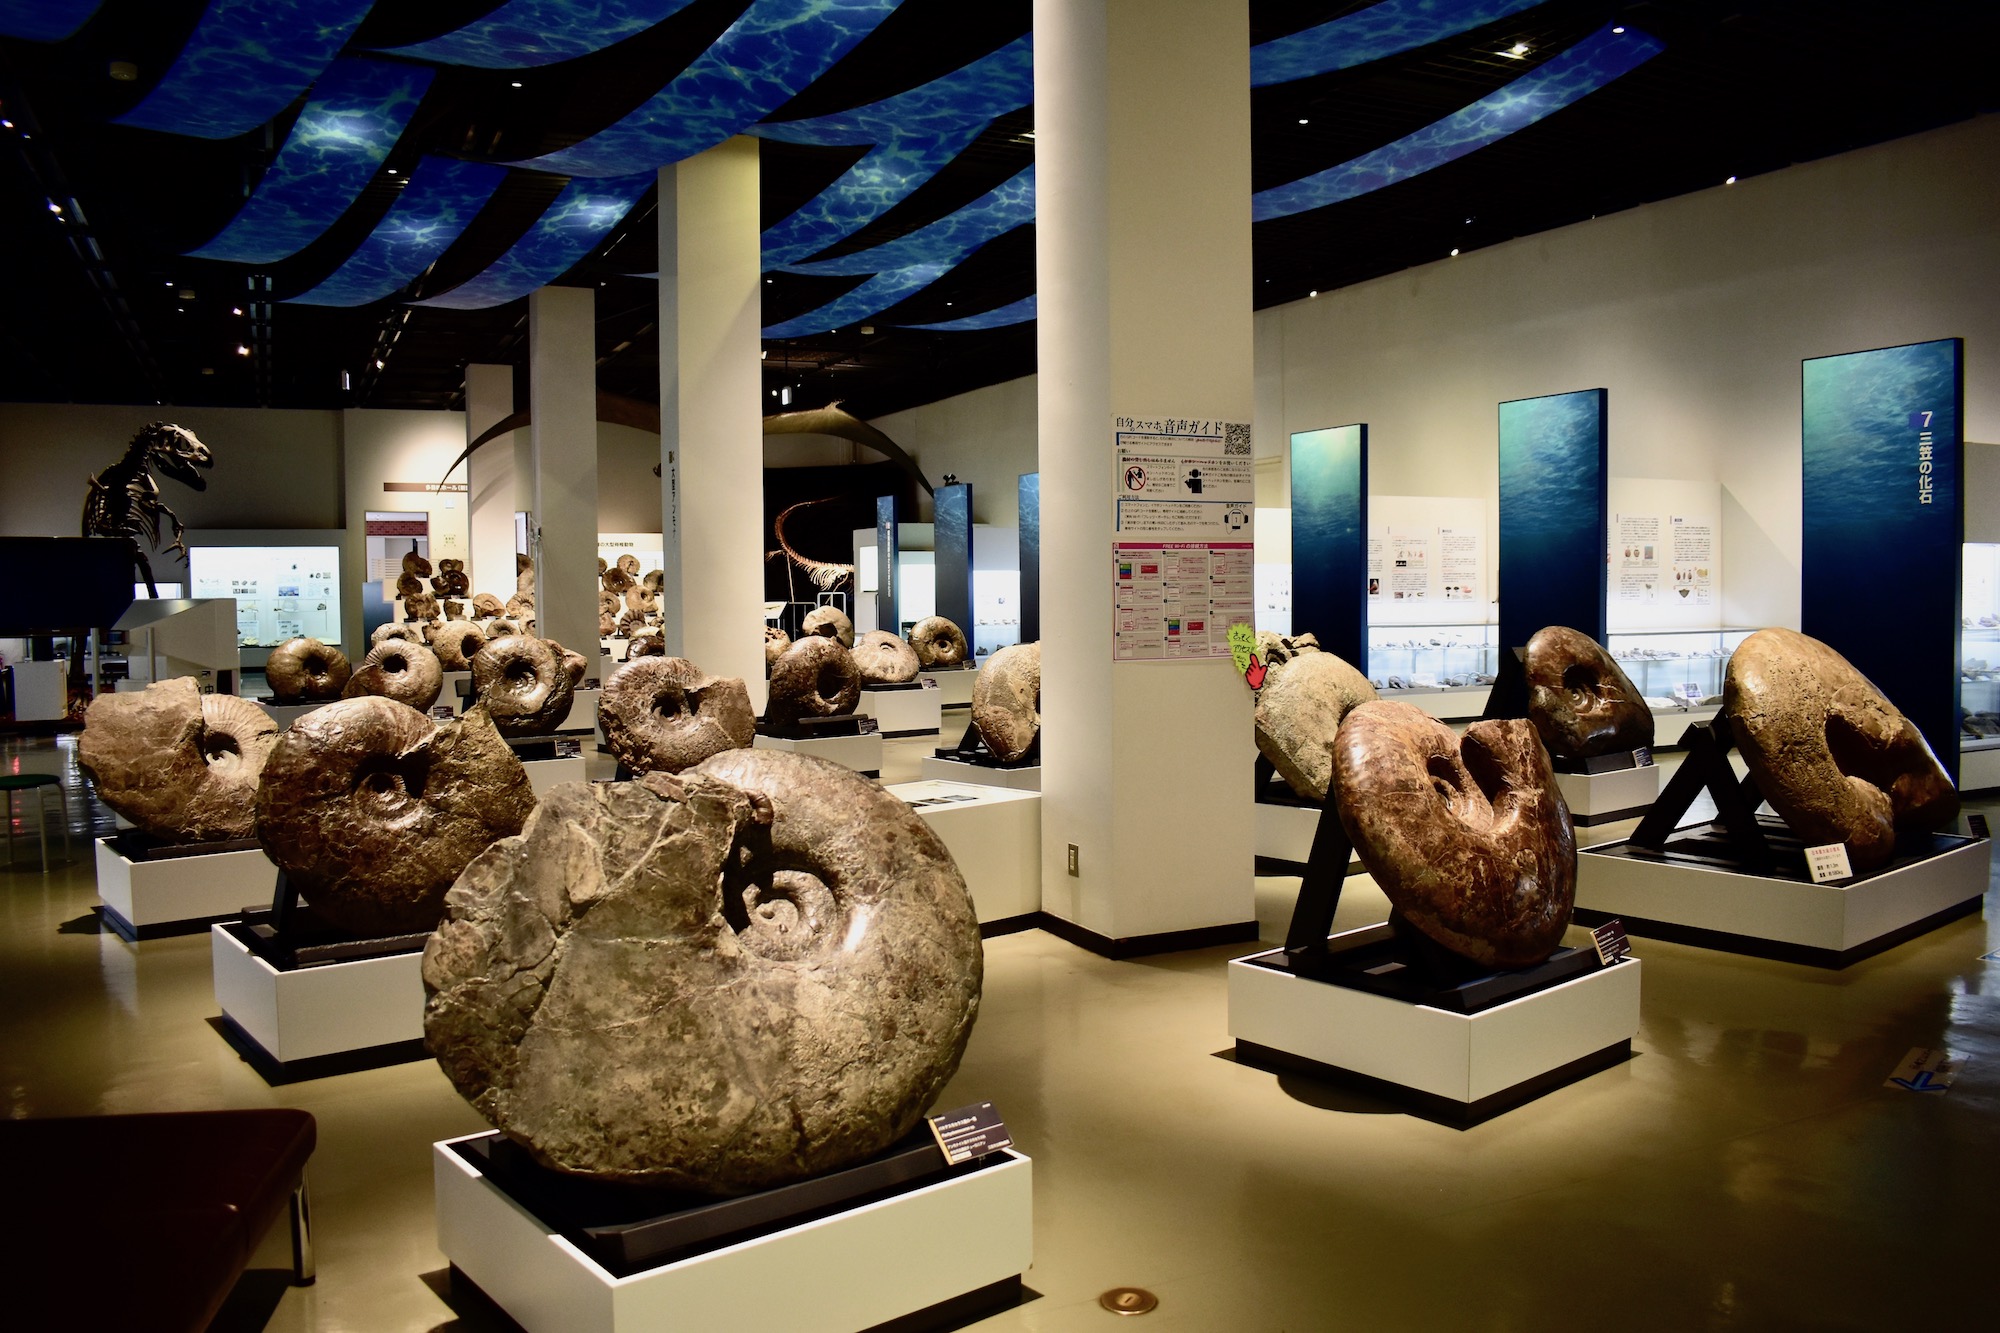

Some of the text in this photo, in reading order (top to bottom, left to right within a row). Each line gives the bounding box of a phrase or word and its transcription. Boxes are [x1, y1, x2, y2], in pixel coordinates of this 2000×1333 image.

[1116, 417, 1223, 436] 自分のスマホで音声ガイド
[1919, 411, 1933, 504] 7 三笠の化石
